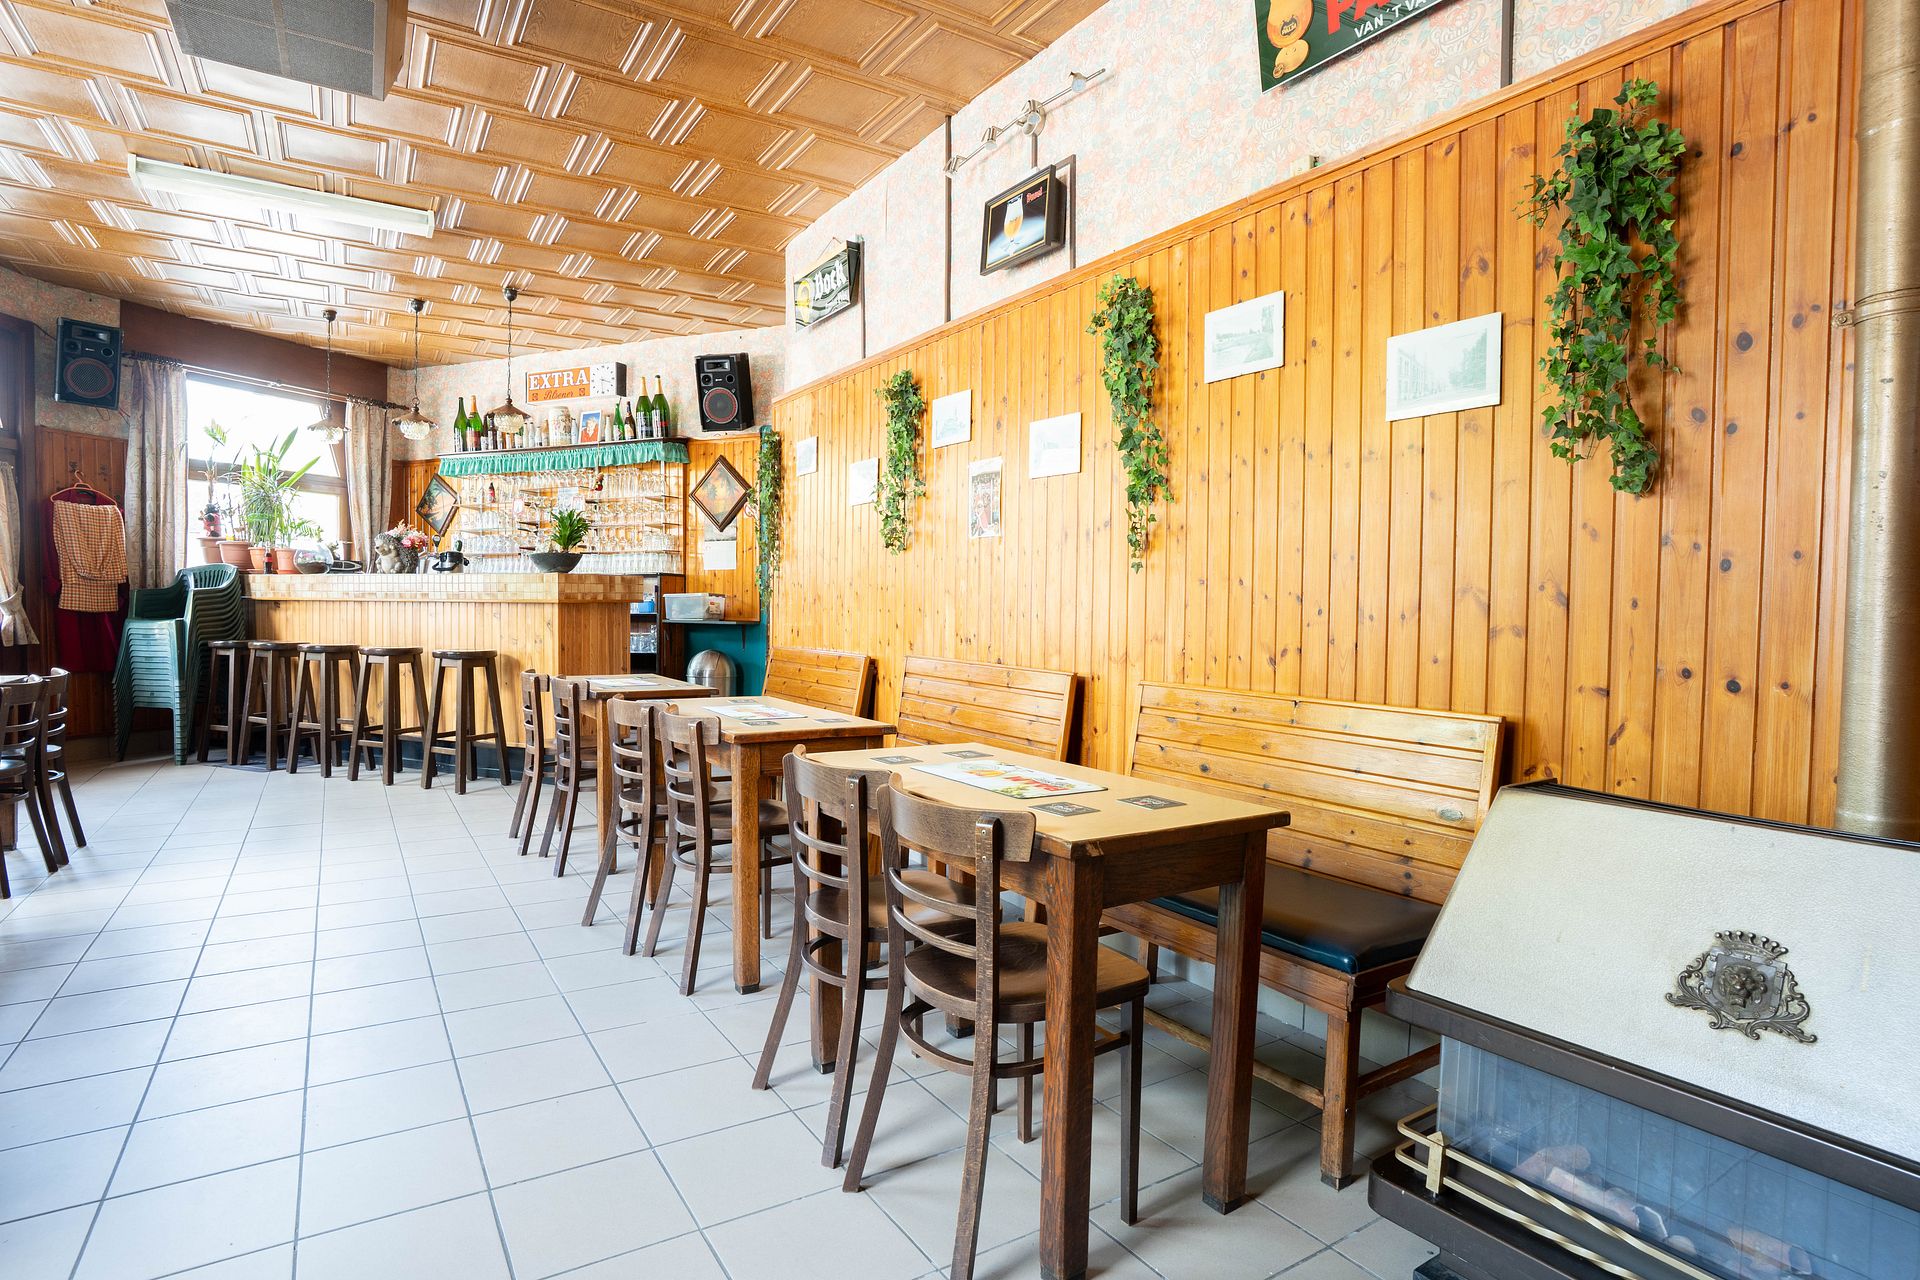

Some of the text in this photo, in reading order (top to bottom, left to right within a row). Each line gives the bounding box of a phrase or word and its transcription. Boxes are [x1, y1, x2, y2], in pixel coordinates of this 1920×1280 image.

[1354, 14, 1384, 38] VAN
[529, 369, 589, 390] EXTRA
[543, 389, 575, 401] Pilsener
